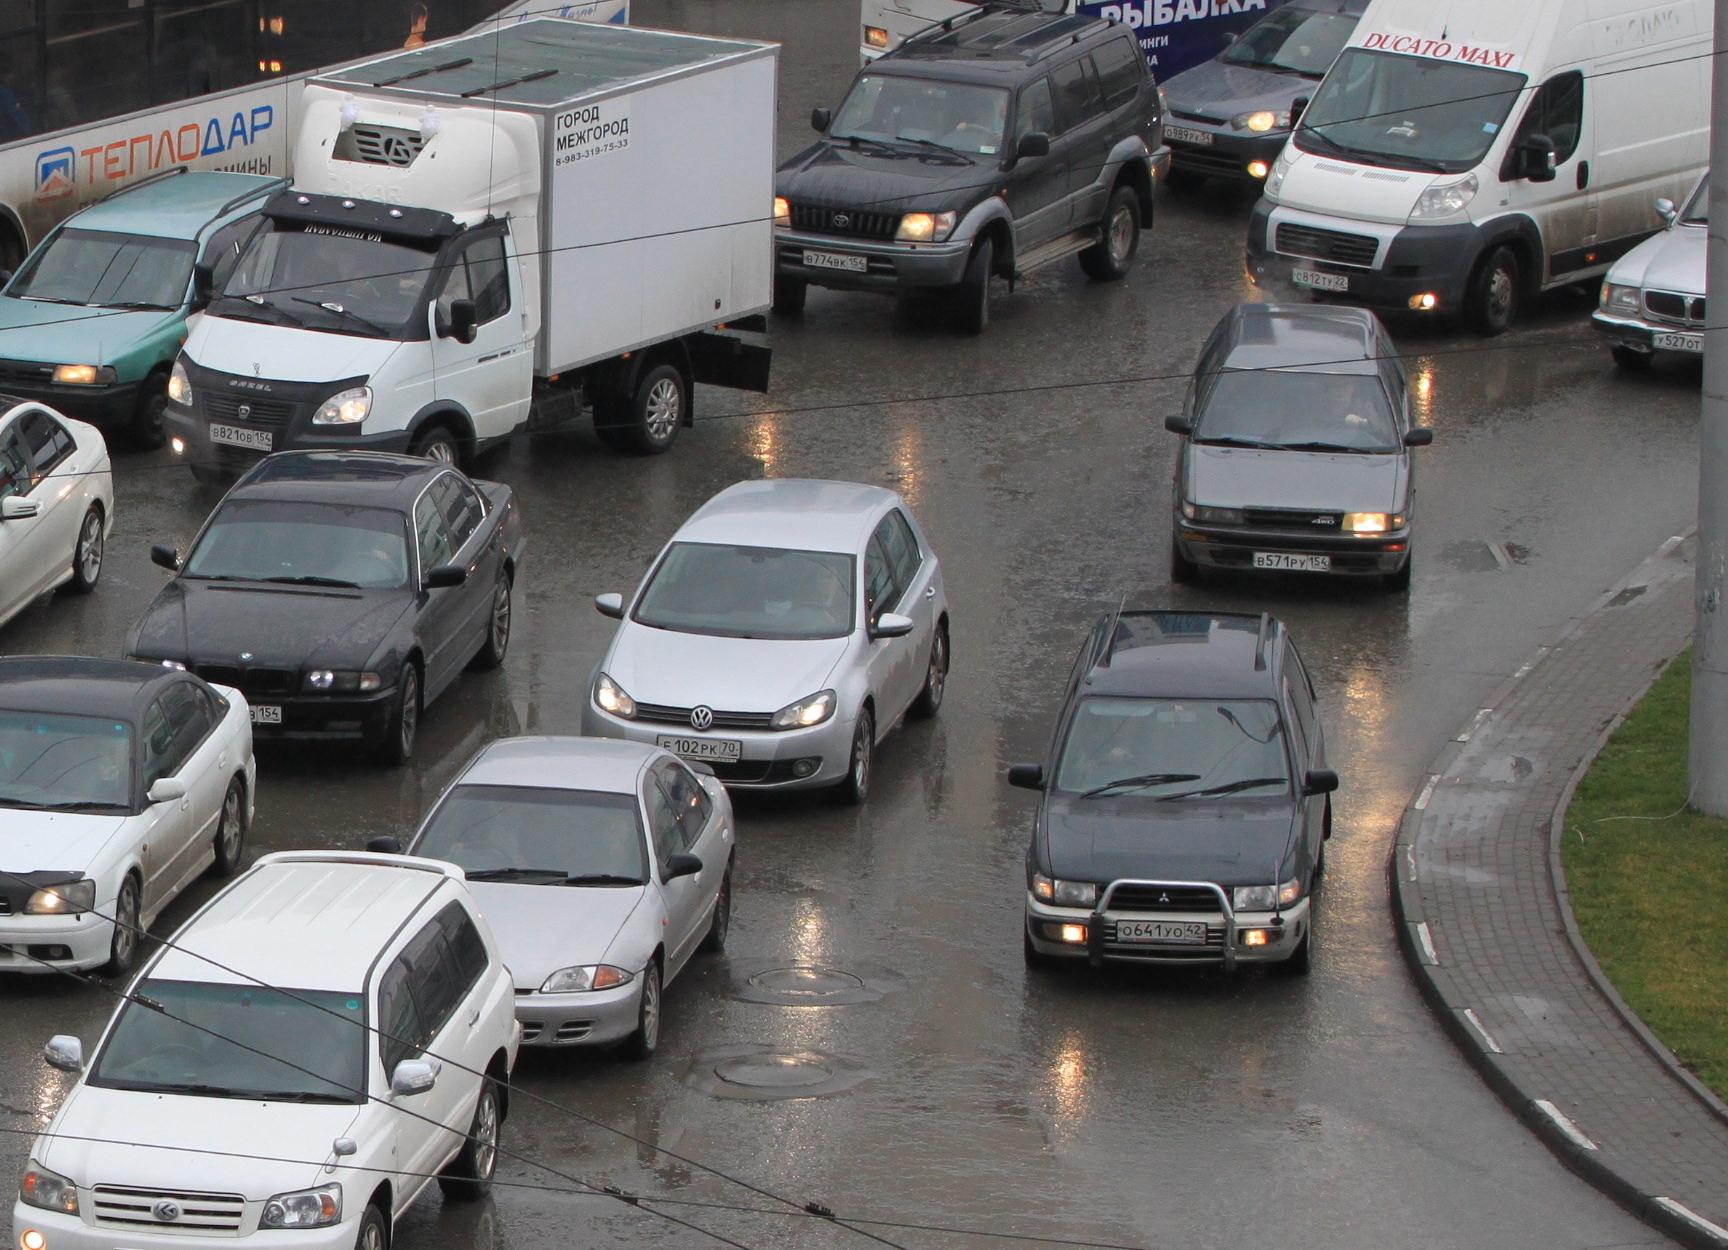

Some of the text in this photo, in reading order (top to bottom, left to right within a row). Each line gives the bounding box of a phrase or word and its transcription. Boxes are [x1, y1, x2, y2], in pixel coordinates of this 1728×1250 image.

[1363, 33, 1516, 69] DUCATO MAXI
[557, 106, 600, 131] ГОРОД
[557, 118, 629, 151] МЕЖГОРОД
[81, 105, 273, 185] ТЕПЛОДАР
[555, 139, 628, 167] 8-983-319-75-33
